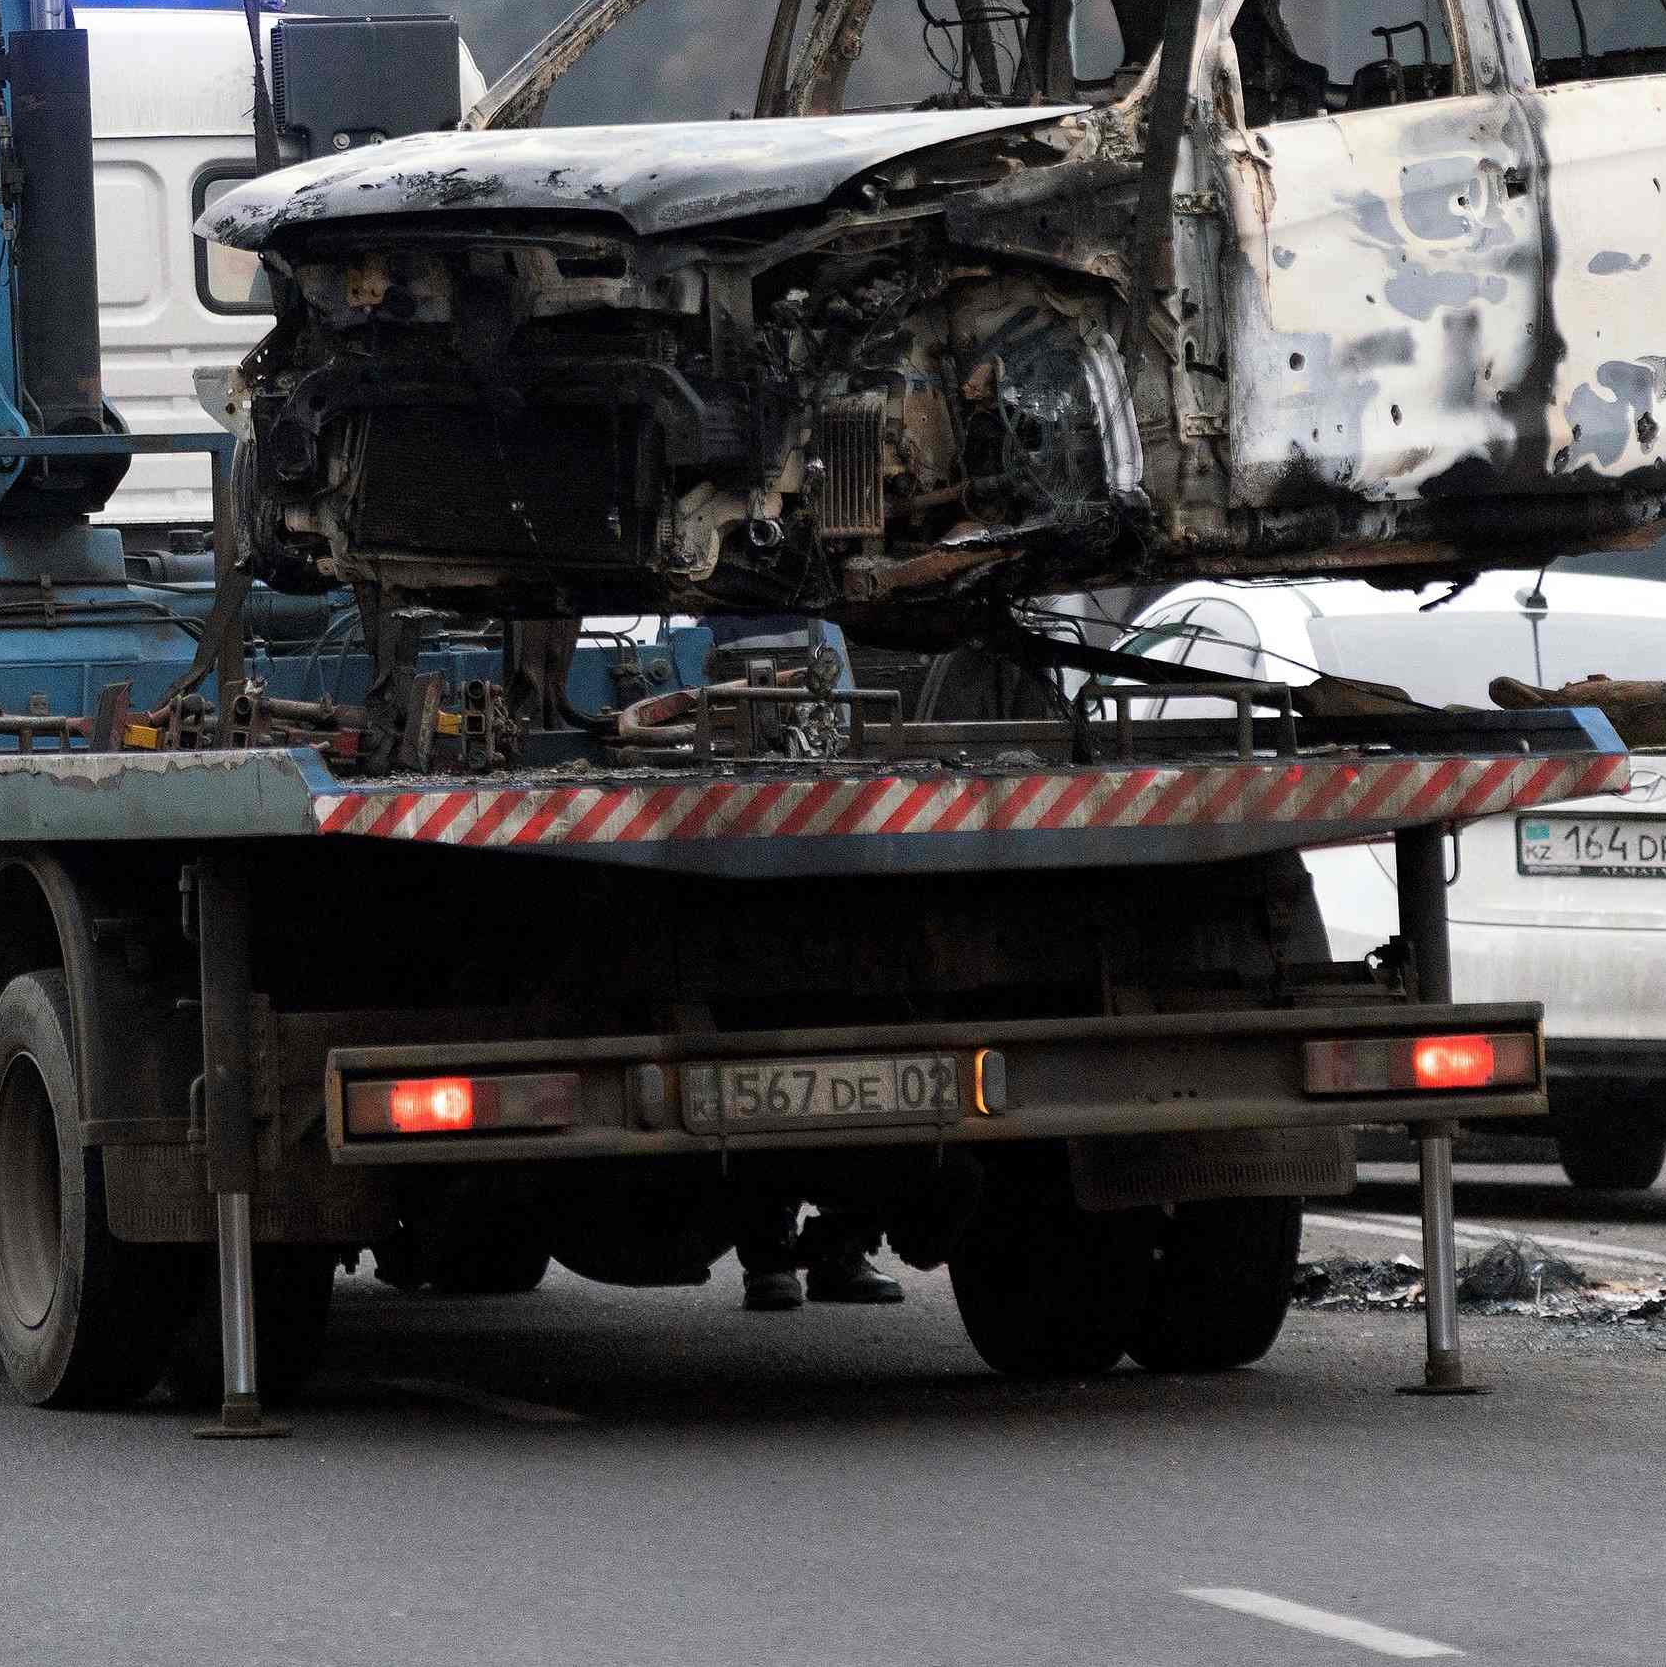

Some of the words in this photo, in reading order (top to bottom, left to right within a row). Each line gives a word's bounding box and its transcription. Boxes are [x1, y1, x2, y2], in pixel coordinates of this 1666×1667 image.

[1525, 845, 1551, 860] KZ
[1564, 825, 1628, 861] 164
[734, 1070, 817, 1115] 567
[831, 1077, 882, 1112] DE
[900, 1064, 955, 1109] 02
